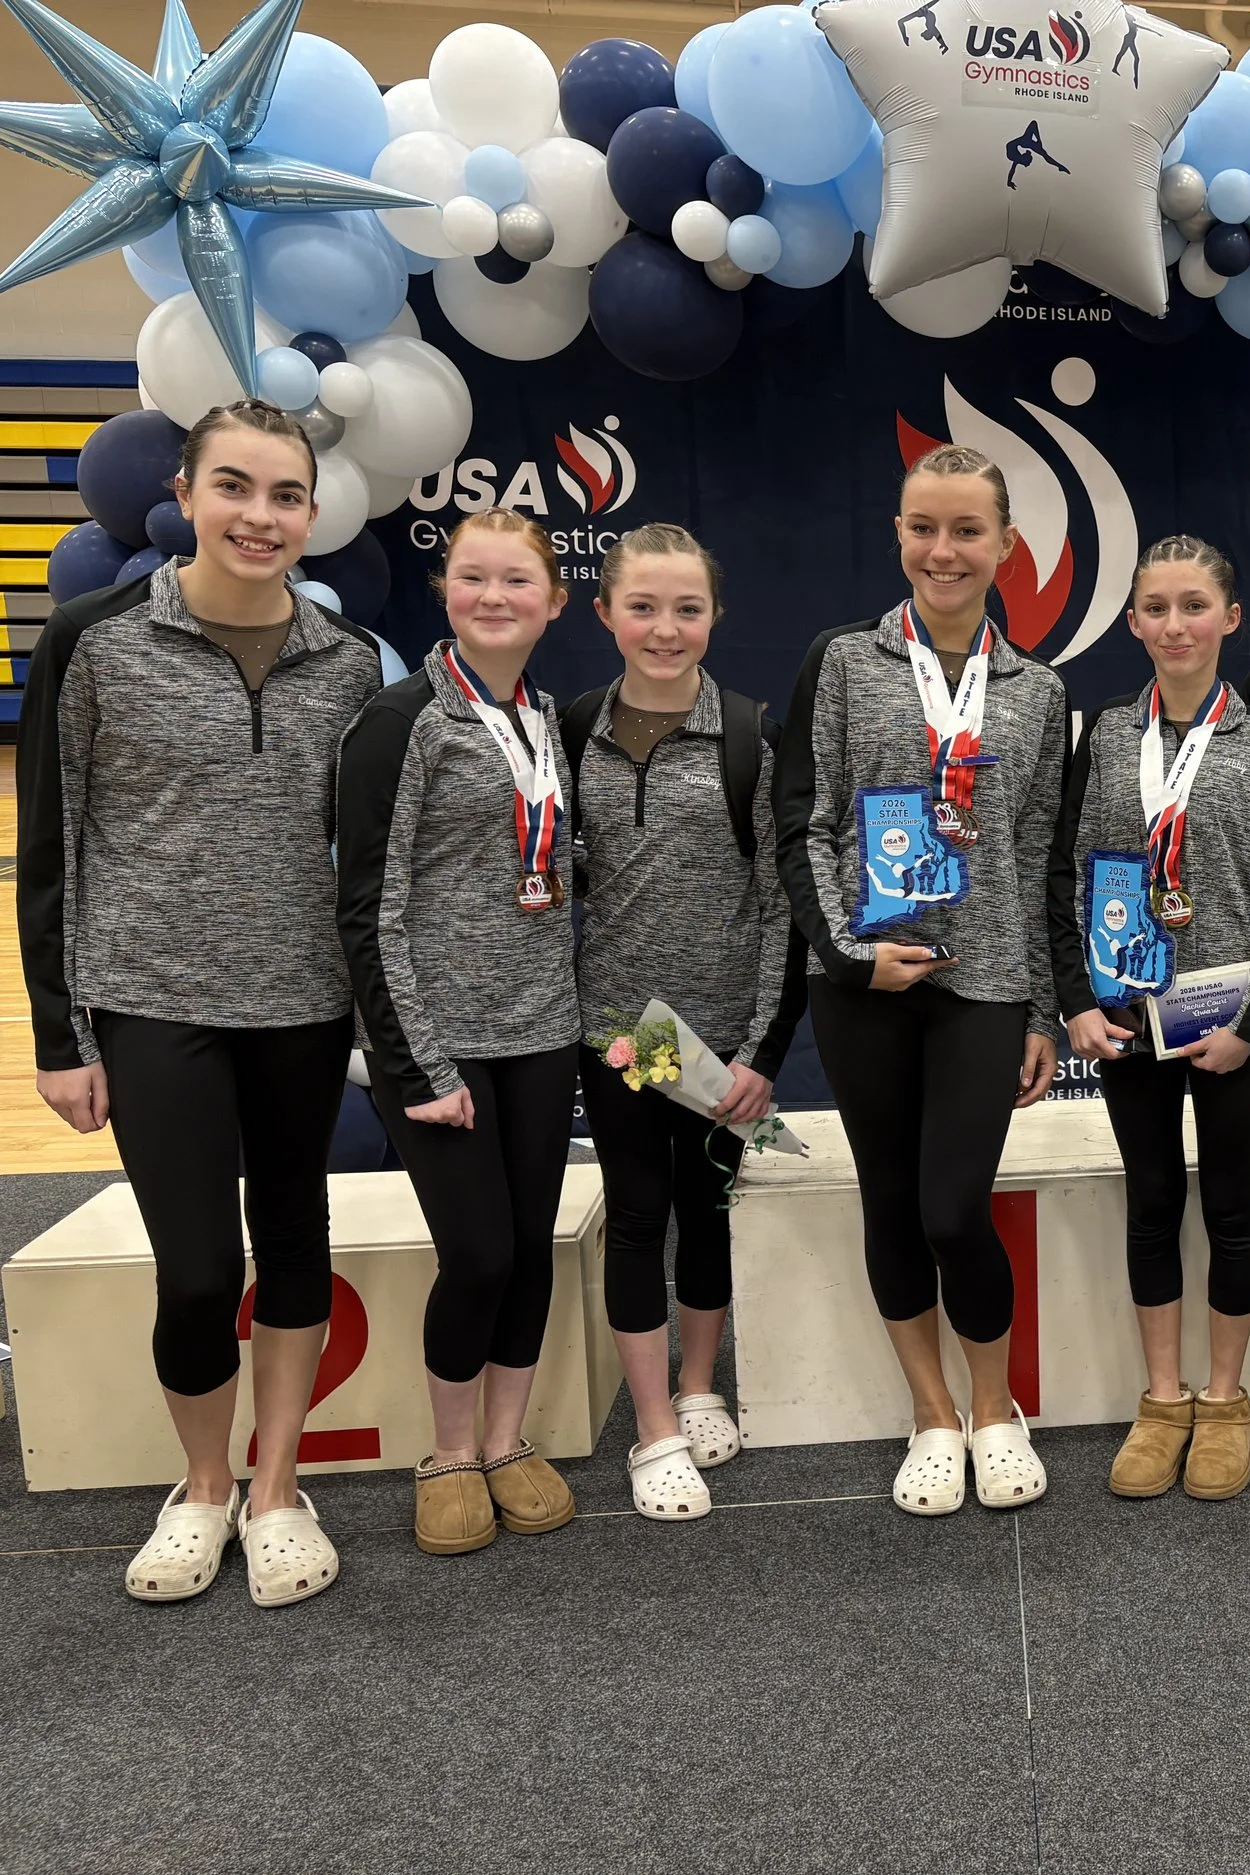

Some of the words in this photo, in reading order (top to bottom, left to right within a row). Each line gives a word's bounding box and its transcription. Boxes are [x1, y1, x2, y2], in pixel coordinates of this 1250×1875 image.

[966, 25, 1043, 62] USA
[965, 61, 1090, 90] Gymnastics
[1014, 87, 1049, 99] RHODE
[1053, 91, 1089, 103] ISLAND
[994, 305, 1047, 320] HODE
[1052, 307, 1112, 322] ISLAND
[408, 457, 549, 516] USA
[919, 662, 927, 676] USA
[959, 672, 977, 717] STATE
[1170, 743, 1196, 790] STATE
[881, 799, 906, 808] 2026
[879, 809, 909, 818] STATE
[1108, 865, 1129, 877] 2026
[1105, 877, 1130, 889] STATE
[1094, 886, 1140, 899] CHAMPIONSHIPS
[1105, 909, 1118, 918] USA
[1165, 998, 1186, 1006] STATE
[1186, 987, 1240, 1002] CHAMPIONSHIPS
[1179, 986, 1196, 995] 2026
